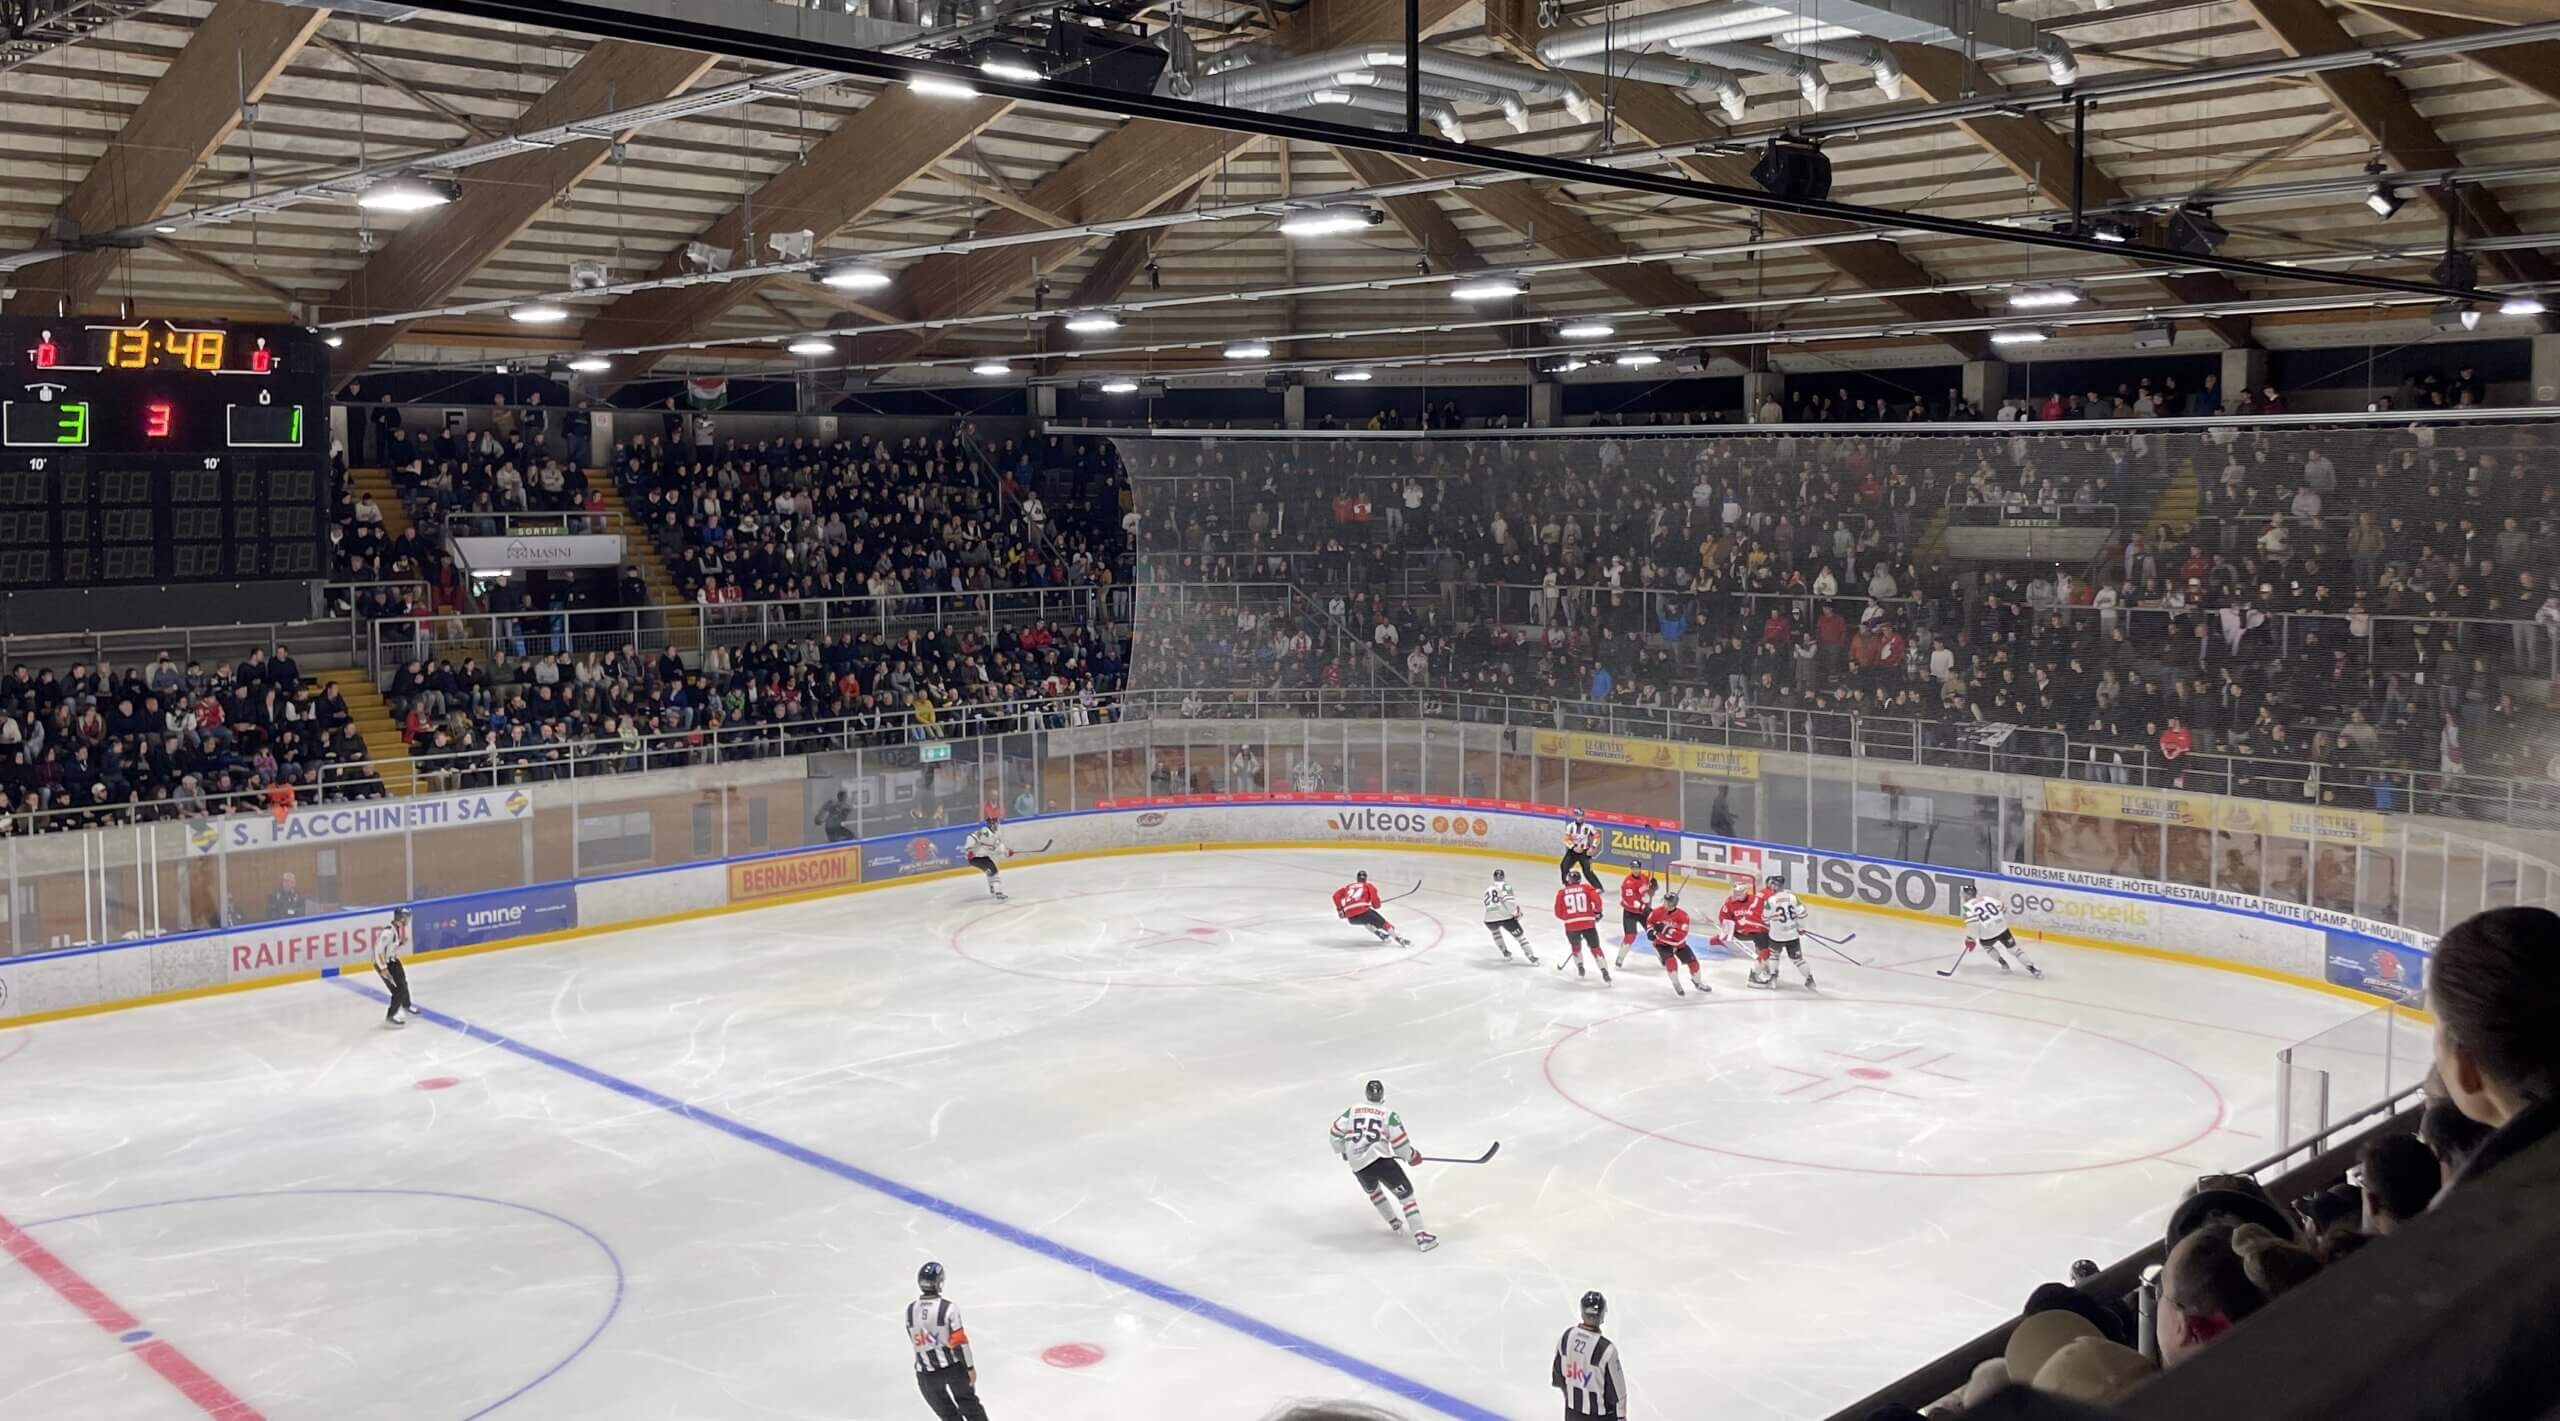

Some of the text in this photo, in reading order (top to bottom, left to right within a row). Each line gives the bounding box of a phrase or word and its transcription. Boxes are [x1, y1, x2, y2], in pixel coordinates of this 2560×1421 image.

[108, 330, 224, 369] 13:48
[57, 404, 85, 442] 3
[147, 404, 170, 436] 3
[290, 408, 300, 442] 1
[530, 546, 571, 559] MASINI
[234, 797, 492, 846] S. FACCHINETTI SA
[1339, 808, 1425, 832] viteos
[1611, 830, 1670, 854] Zuttion
[743, 856, 847, 892] BERNASCONI
[1769, 850, 1975, 916] TISSOT
[1483, 889, 1500, 906] 28
[1563, 892, 1587, 914] 90
[2008, 865, 2065, 882] TOURISME
[2068, 873, 2113, 889] NATURE
[2244, 897, 2259, 910] LA
[2262, 900, 2301, 919] TRUITE
[1974, 902, 2000, 922] 20
[233, 922, 409, 971] RAIFFEIS
[1353, 1117, 1382, 1143] 55
[914, 1328, 939, 1346] sky
[1574, 1339, 1586, 1354] 22
[1566, 1361, 1592, 1388] sky
